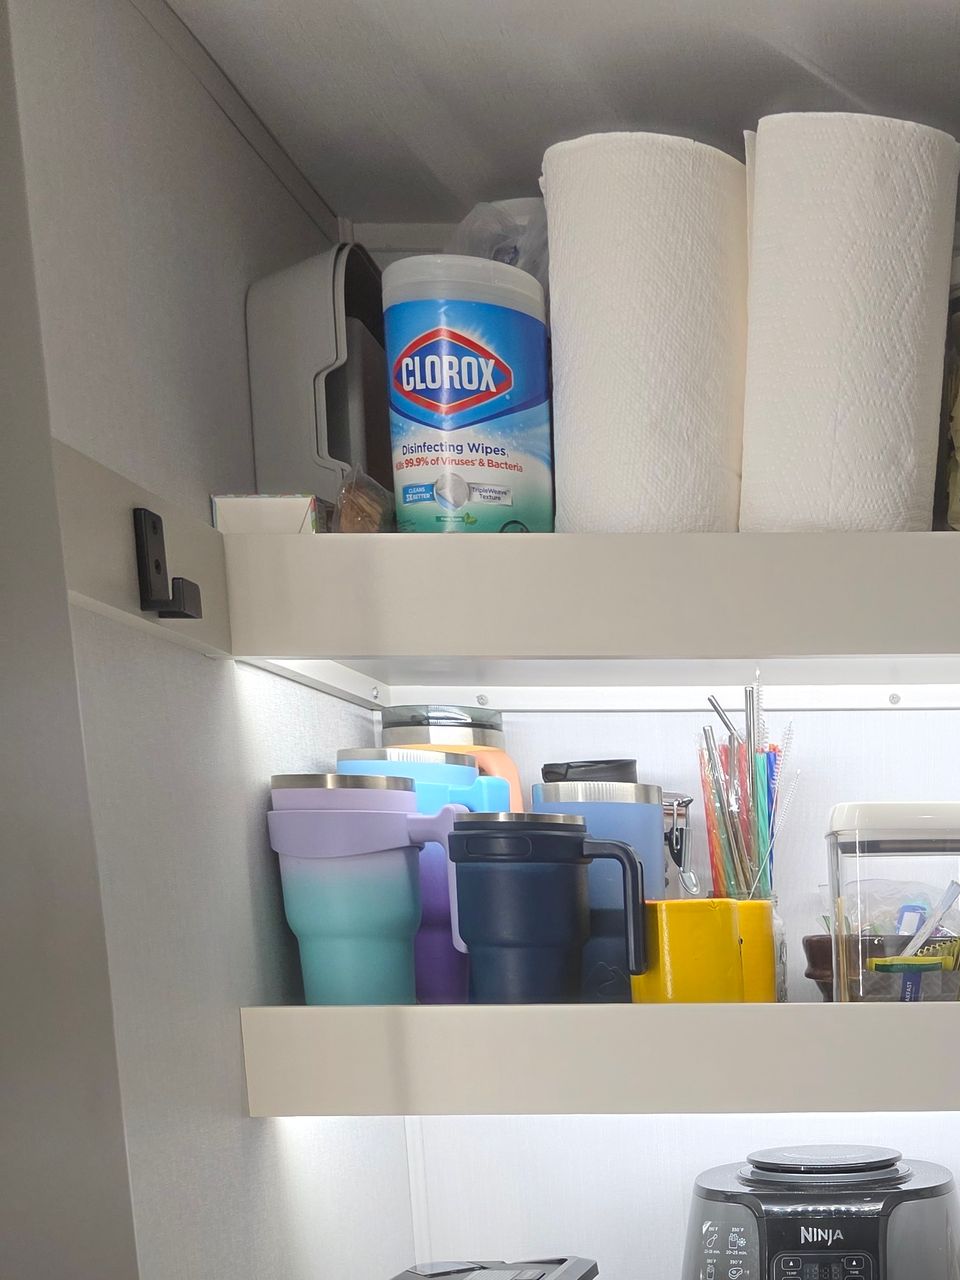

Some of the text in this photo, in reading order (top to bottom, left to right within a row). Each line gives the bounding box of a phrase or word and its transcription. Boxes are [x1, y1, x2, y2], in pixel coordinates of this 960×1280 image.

[402, 355, 496, 392] CLOROX
[402, 441, 464, 456] Disinfecting
[404, 456, 429, 468] 99.9%
[430, 457, 439, 466] of
[478, 458, 485, 467] &
[487, 458, 523, 472] Bacteria
[800, 1226, 844, 1246] NINJA
